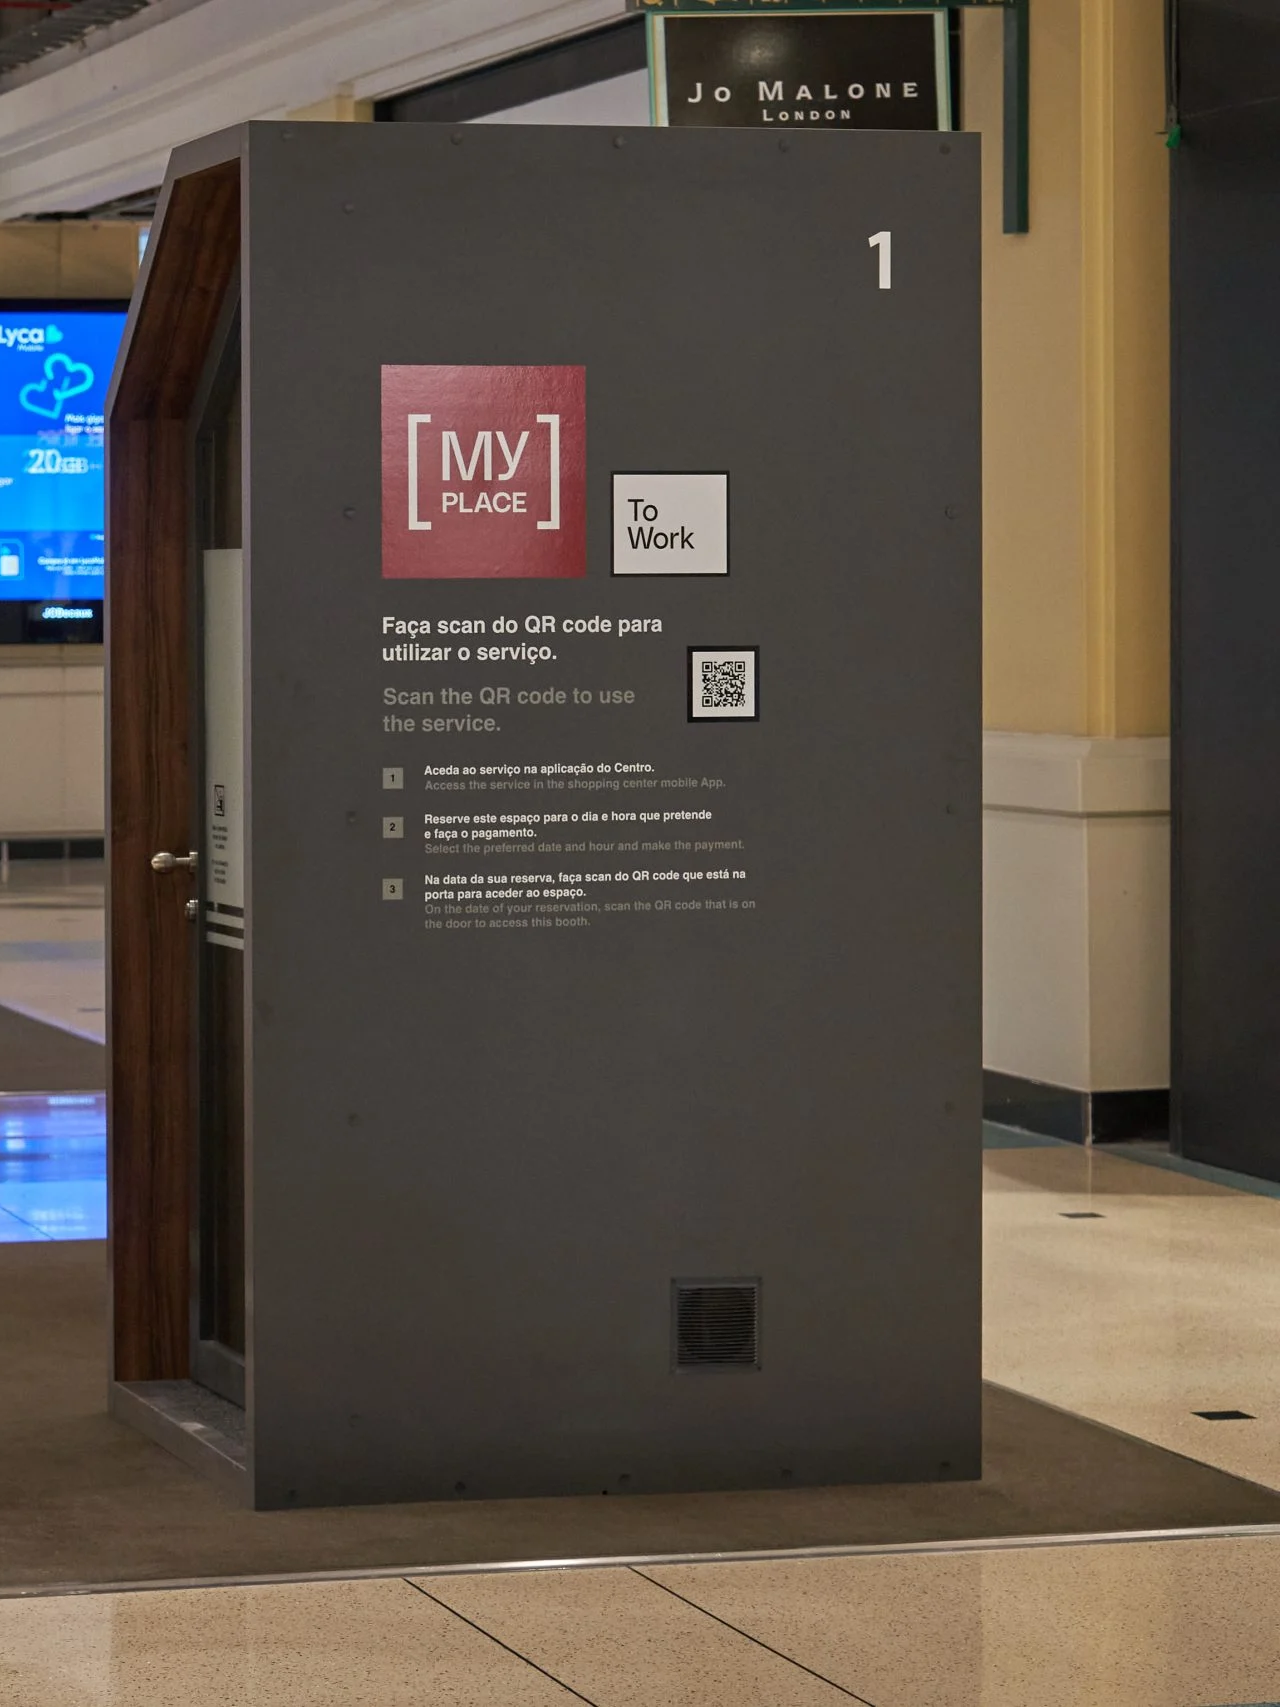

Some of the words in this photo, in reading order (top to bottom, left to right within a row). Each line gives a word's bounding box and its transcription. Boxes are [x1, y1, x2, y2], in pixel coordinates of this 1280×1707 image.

[868, 231, 891, 289] 1
[442, 492, 527, 513] PLACE
[628, 498, 658, 522] To
[628, 526, 695, 550] Work
[382, 617, 432, 638] Faça
[438, 619, 486, 634] scan
[492, 616, 518, 634] do
[524, 616, 556, 634] QR
[562, 616, 611, 634] code
[618, 618, 662, 636] para
[382, 644, 451, 662] utilizar
[458, 646, 470, 662] o
[476, 643, 557, 664] serviço.
[384, 688, 434, 706] Scan
[440, 688, 474, 705] the
[480, 686, 511, 706] QR
[518, 686, 566, 704] code
[572, 688, 592, 704] to
[599, 690, 634, 704] use
[383, 714, 415, 732] the
[422, 714, 501, 732] service.
[424, 766, 460, 776] Aceda
[462, 767, 476, 776] ao
[480, 764, 520, 776] serviço
[524, 766, 537, 774] na
[540, 764, 594, 776] aplicação
[596, 764, 611, 773] do
[614, 762, 654, 772] Centro.
[391, 774, 395, 782] 1
[425, 780, 466, 790] Access
[469, 780, 487, 790] the
[490, 780, 530, 790] service
[534, 780, 544, 789] in
[547, 779, 564, 788] the
[568, 778, 620, 790] shopping
[622, 779, 658, 788] center
[660, 778, 698, 788] mobile
[700, 777, 726, 789] App.
[424, 814, 470, 824] Reserve
[473, 814, 496, 823] este
[500, 814, 540, 825] espaço
[544, 814, 568, 824] para
[582, 812, 598, 821] dia
[602, 813, 608, 821] e
[612, 811, 636, 820] hora
[640, 812, 660, 822] que
[663, 810, 712, 822] pretende
[390, 823, 396, 832] 2
[424, 830, 431, 838] e
[434, 829, 458, 840] faça
[461, 830, 468, 838] o
[472, 828, 537, 840] pagamento.
[425, 844, 459, 854] Select
[462, 844, 480, 853] the
[484, 842, 534, 855] preferred
[538, 842, 562, 852] date
[565, 842, 585, 852] and
[589, 841, 614, 850] hour
[618, 841, 638, 850] and
[642, 840, 670, 850] make
[674, 840, 692, 850] the
[695, 840, 744, 852] payment.
[424, 875, 440, 884] Na
[443, 874, 467, 884] data
[470, 874, 484, 884] da
[488, 876, 507, 884] sua
[510, 874, 555, 884] reserva,
[558, 872, 582, 884] faça
[585, 873, 612, 882] scan
[615, 872, 629, 881] do
[632, 870, 650, 881] QR
[653, 870, 680, 880] code
[682, 872, 702, 882] que
[706, 869, 729, 879] está
[732, 870, 746, 878] na
[390, 885, 396, 893] 3
[424, 890, 454, 901] porta
[457, 890, 482, 900] para
[485, 888, 523, 898] aceder
[526, 889, 540, 898] ao
[543, 888, 586, 898] espaço.
[424, 904, 440, 914] On
[444, 904, 462, 914] the
[465, 904, 489, 913] date
[492, 903, 504, 912] of
[506, 904, 532, 915] your
[536, 902, 600, 912] reservation,
[604, 902, 630, 911] scan
[634, 900, 651, 910] the
[654, 900, 672, 910] QR
[674, 900, 701, 910] code
[705, 899, 726, 909] that
[729, 899, 738, 908] is
[742, 900, 756, 908] on
[424, 919, 442, 928] the
[446, 918, 470, 928] door
[475, 919, 486, 928] to
[490, 919, 528, 927] access
[532, 917, 552, 926] this
[556, 916, 590, 926] booth.
